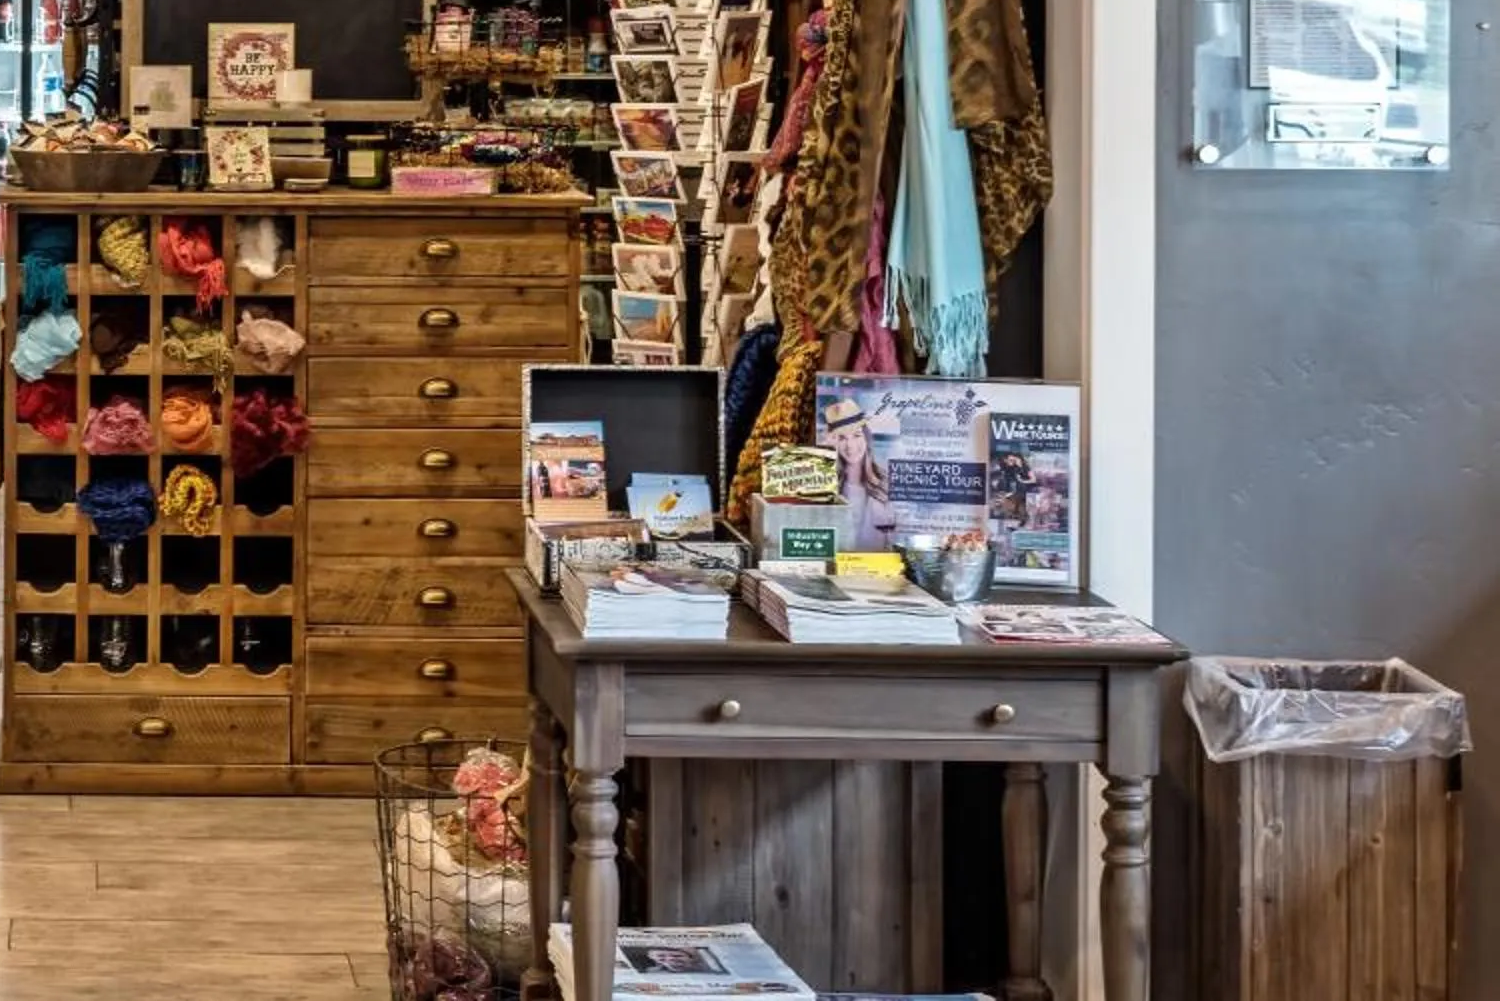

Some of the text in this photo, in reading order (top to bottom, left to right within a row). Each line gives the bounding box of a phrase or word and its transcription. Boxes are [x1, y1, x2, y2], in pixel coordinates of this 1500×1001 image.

[245, 53, 264, 64] BE
[230, 64, 276, 77] HAPPY
[891, 462, 961, 476] VINEYARD
[891, 473, 983, 488] PICNIC TOUR
